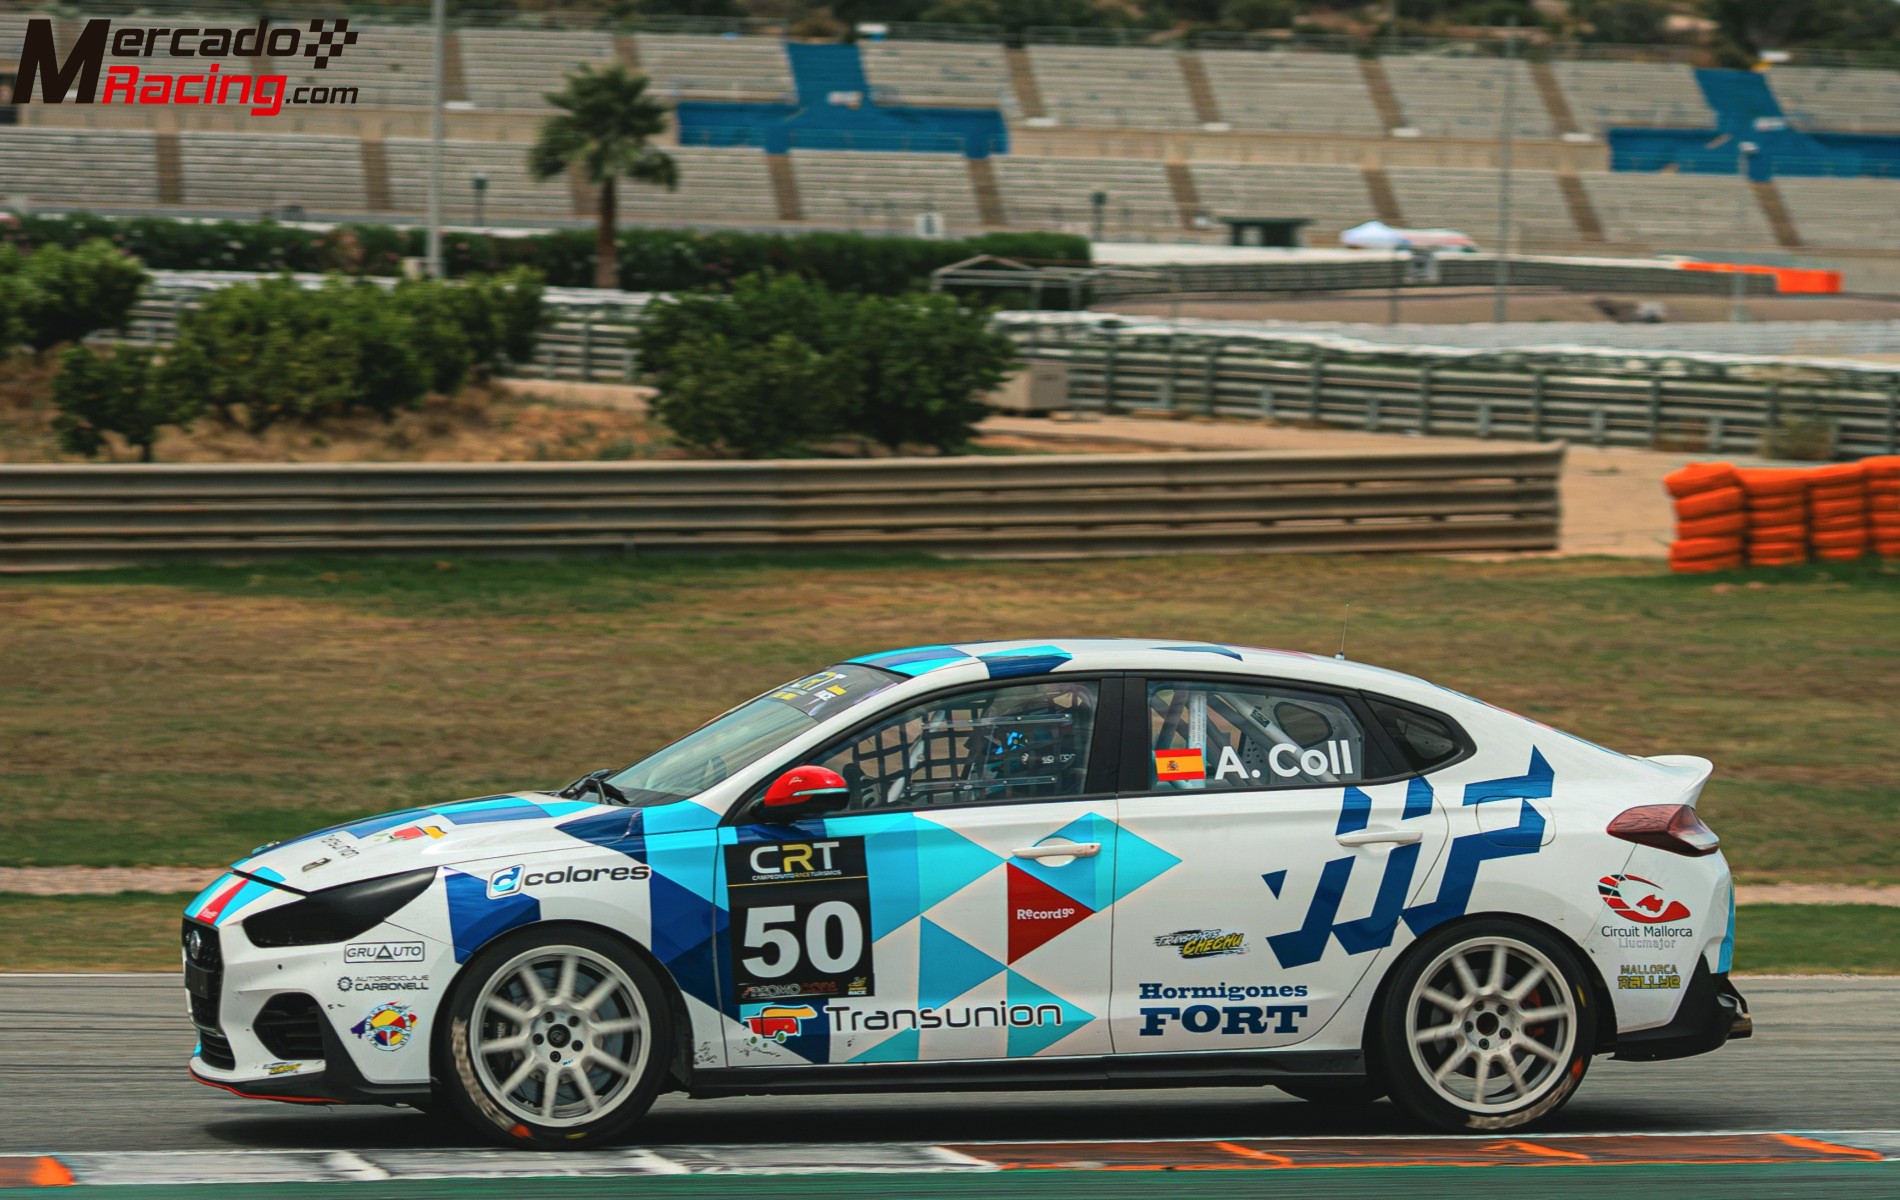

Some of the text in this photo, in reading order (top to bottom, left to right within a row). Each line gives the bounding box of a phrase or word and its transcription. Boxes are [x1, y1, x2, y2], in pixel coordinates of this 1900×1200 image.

[1214, 740, 1354, 780] A. Coll
[749, 841, 840, 874] CRT
[524, 865, 650, 886] colores
[741, 900, 864, 978] 50
[1601, 926, 1693, 937] Circuit Mallorca
[1181, 932, 1245, 956] CHECHU
[1618, 938, 1677, 950] Llucmajor
[1620, 963, 1678, 975] MALLORCA
[354, 982, 429, 992] CARBONELL
[1139, 982, 1308, 1001] Hormigones
[824, 1000, 1063, 1032] Transunion
[1139, 1004, 1308, 1037] FORT
